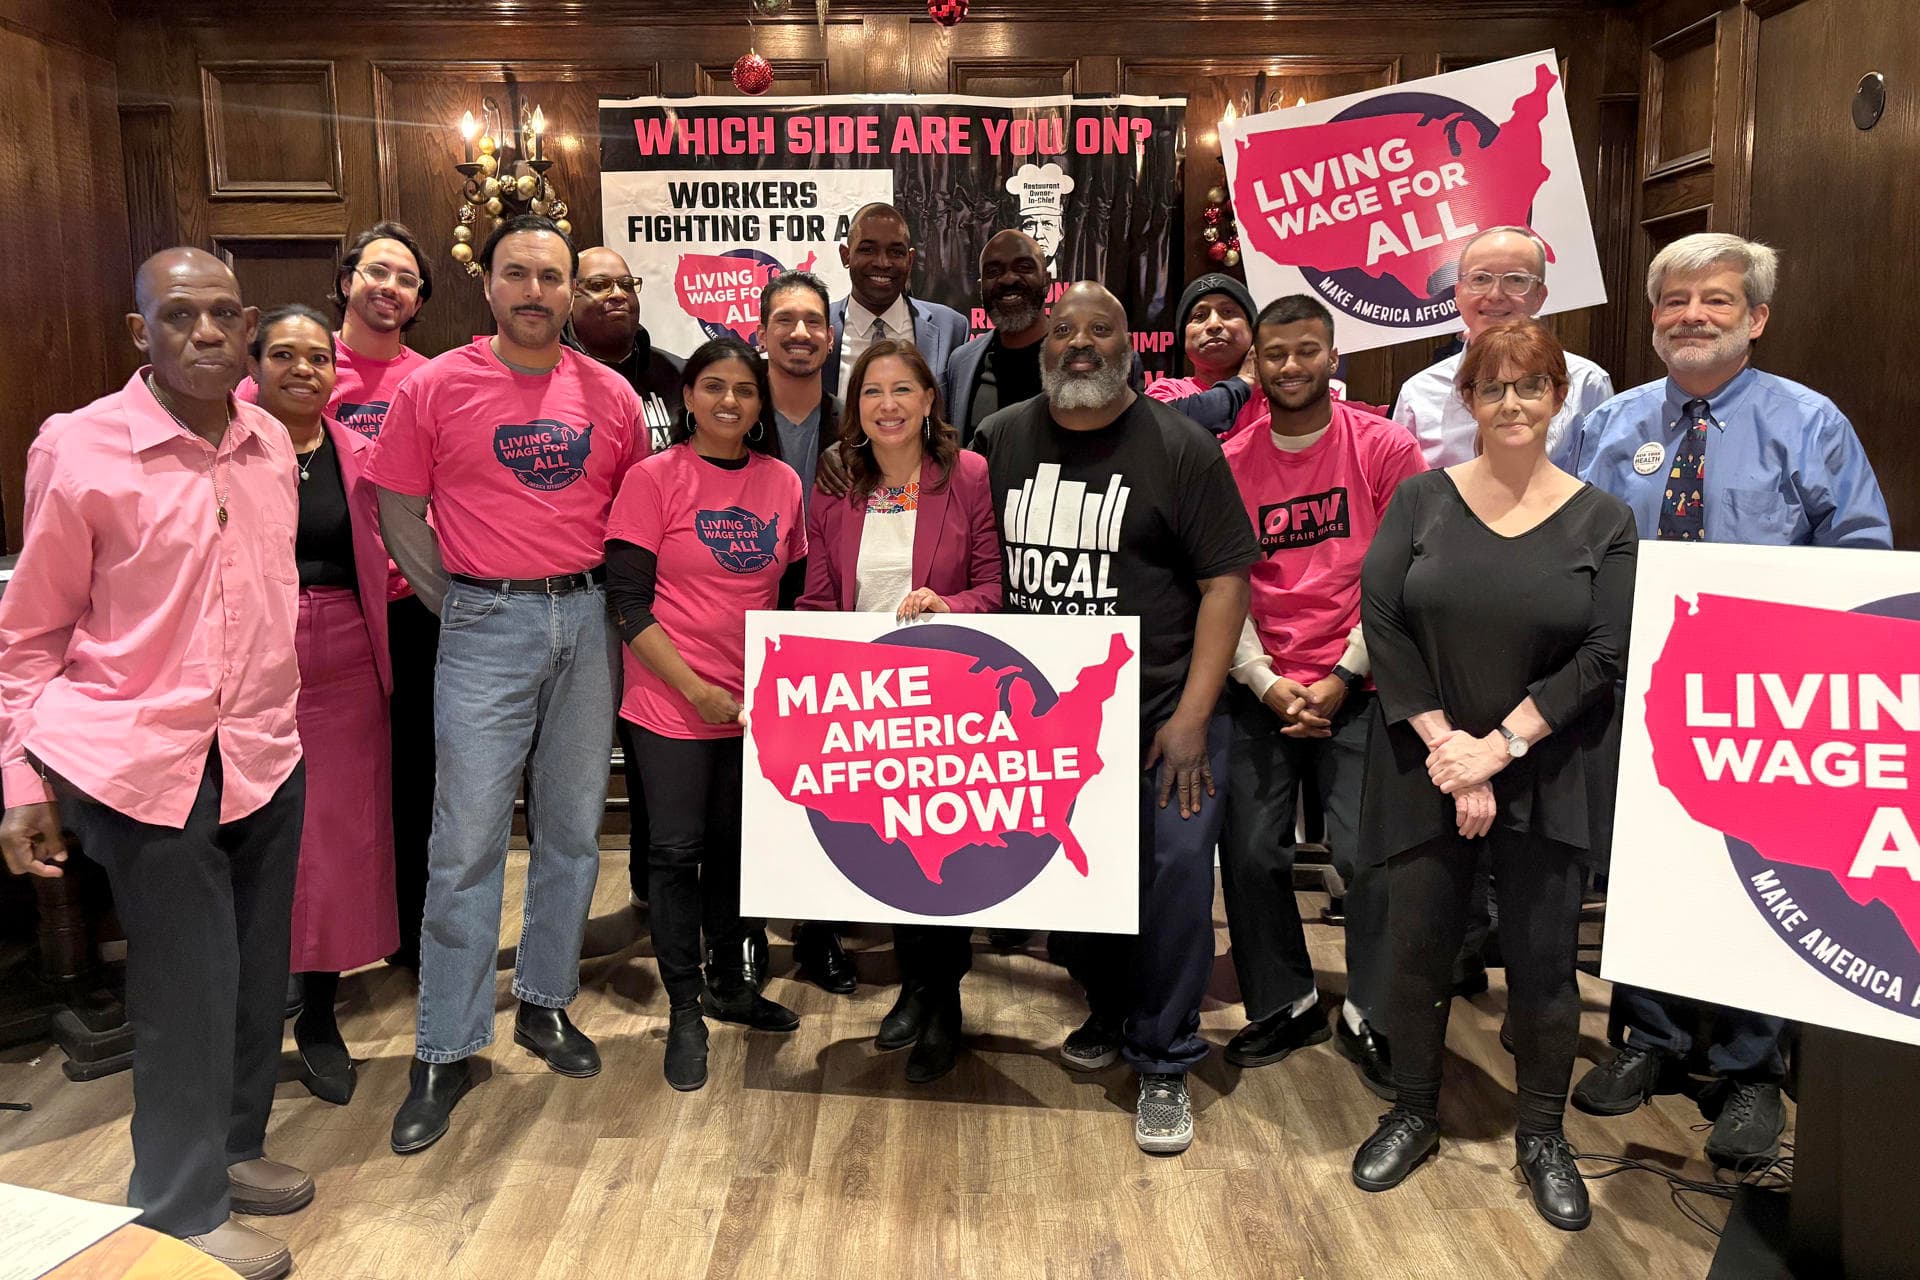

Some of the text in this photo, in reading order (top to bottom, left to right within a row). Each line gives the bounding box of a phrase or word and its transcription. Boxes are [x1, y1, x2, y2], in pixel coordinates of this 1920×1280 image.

[633, 115, 1153, 156] WHICH SIDE ARE YOU ON?
[1023, 182, 1060, 190] Restaurant
[1253, 137, 1415, 214] LIVING
[667, 181, 818, 209] WORKERS
[1265, 162, 1469, 240] WAGE FOR
[627, 215, 761, 243] FIGHTING
[769, 215, 826, 242] FOR
[1365, 202, 1479, 267] ALL
[682, 269, 754, 291] LIVING
[686, 286, 764, 305] WAGE FO
[1318, 276, 1458, 323] MAKE AMERICA AFFOR
[725, 302, 761, 324] AL
[340, 413, 386, 425] LIVING
[498, 432, 553, 450] LIVING
[502, 442, 569, 460] WAGE FOR
[533, 454, 569, 471] ALL
[700, 519, 744, 530] LIVING
[1264, 493, 1342, 535] OFW
[703, 530, 759, 539] WAGE FOR
[729, 540, 762, 553] ALL
[1261, 523, 1345, 545] ONE FAIR WAGE
[1005, 545, 1119, 598] VOCAL
[1009, 591, 1117, 616] NEW YORK
[775, 665, 932, 718] MAKE
[820, 710, 1019, 754] AMERICA
[790, 746, 1081, 797] AFFORDABLE
[1692, 737, 1908, 790] WAGE
[882, 785, 1047, 839] NOW!
[1750, 868, 1902, 1003] MAKE AMERICA
